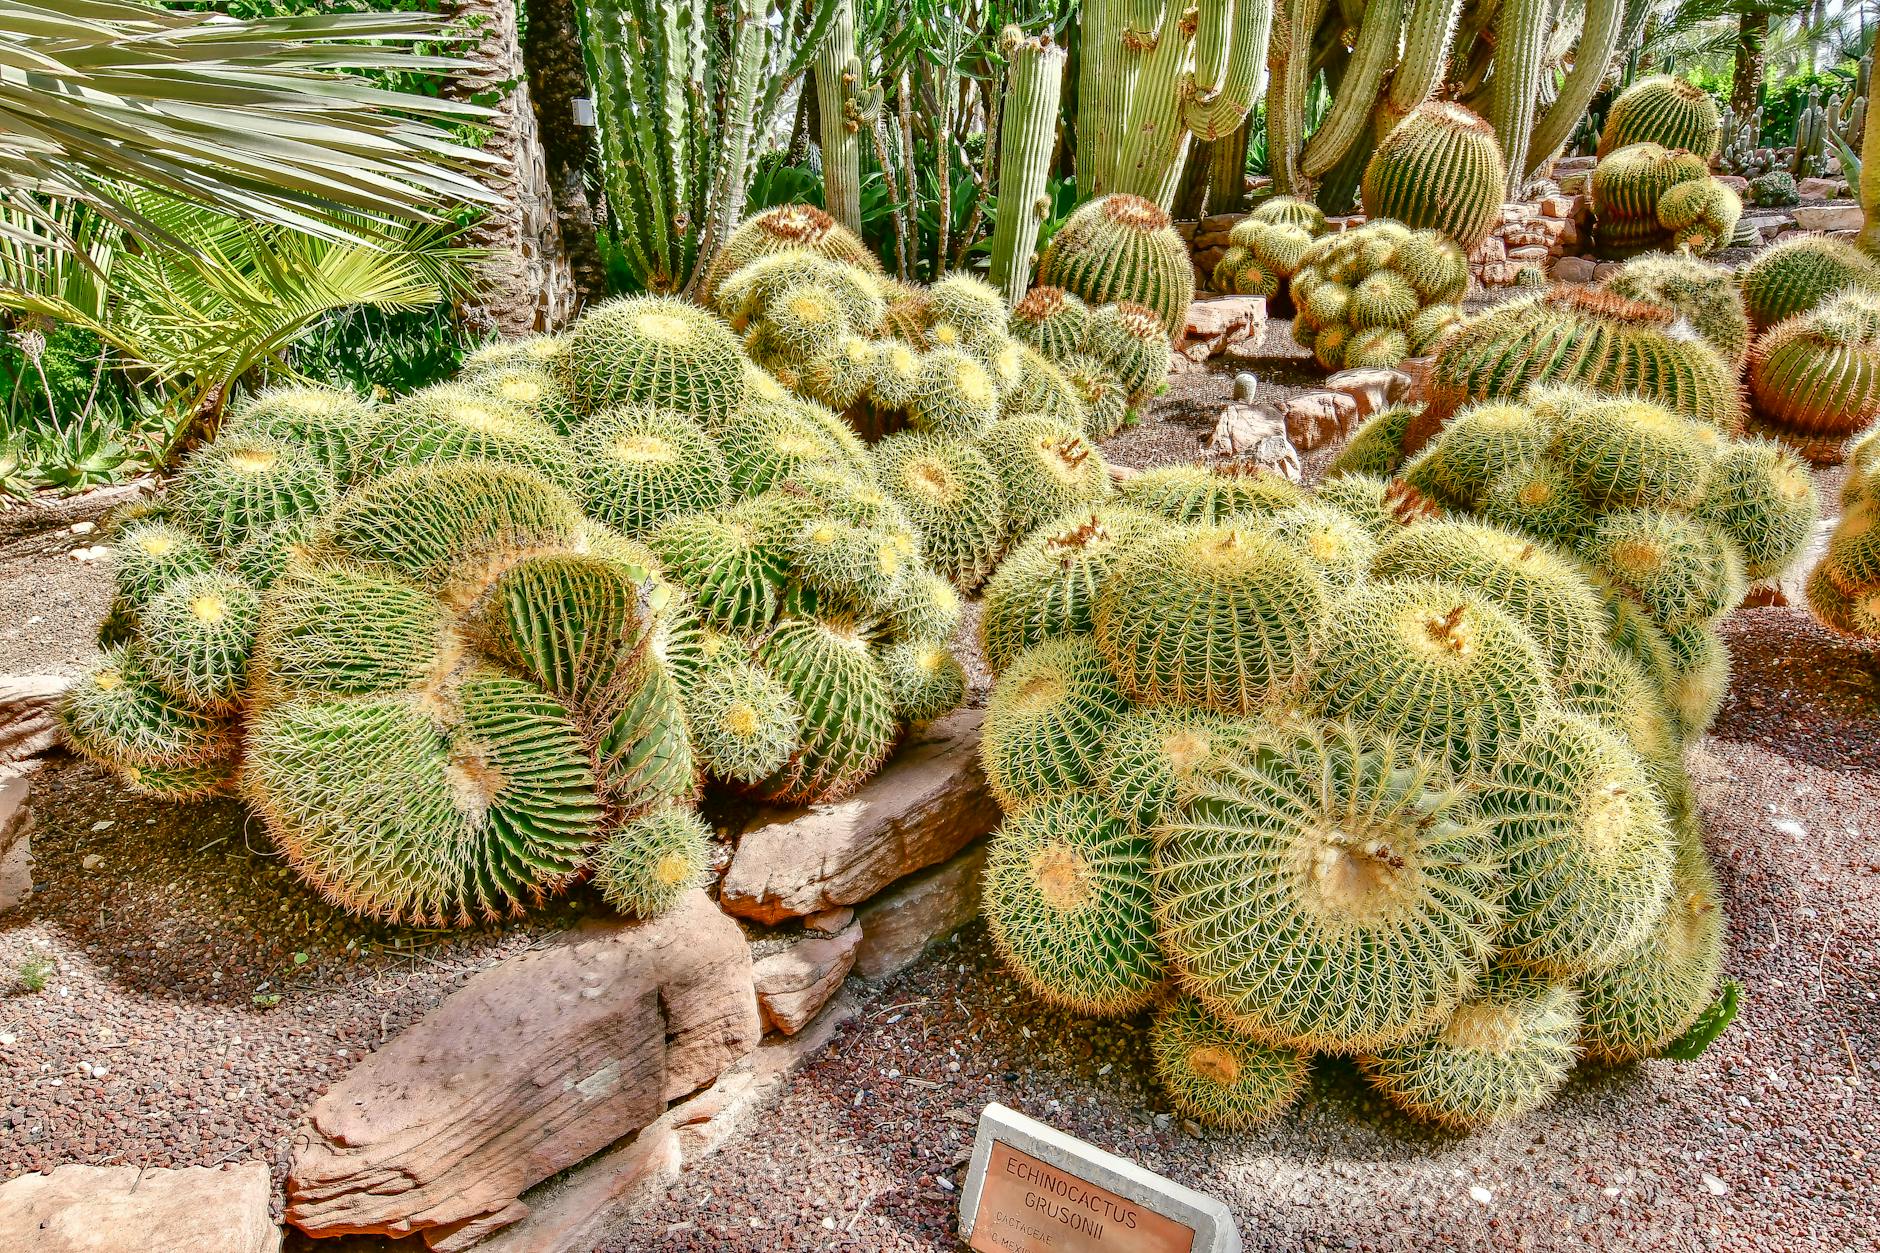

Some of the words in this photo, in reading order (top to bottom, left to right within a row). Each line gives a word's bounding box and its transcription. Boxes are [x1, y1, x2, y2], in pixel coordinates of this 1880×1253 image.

[1006, 1157, 1137, 1229] ECHINOCACTUS
[1025, 1191, 1104, 1240] GRUSONII
[996, 1211, 1053, 1246] CACTACEAE
